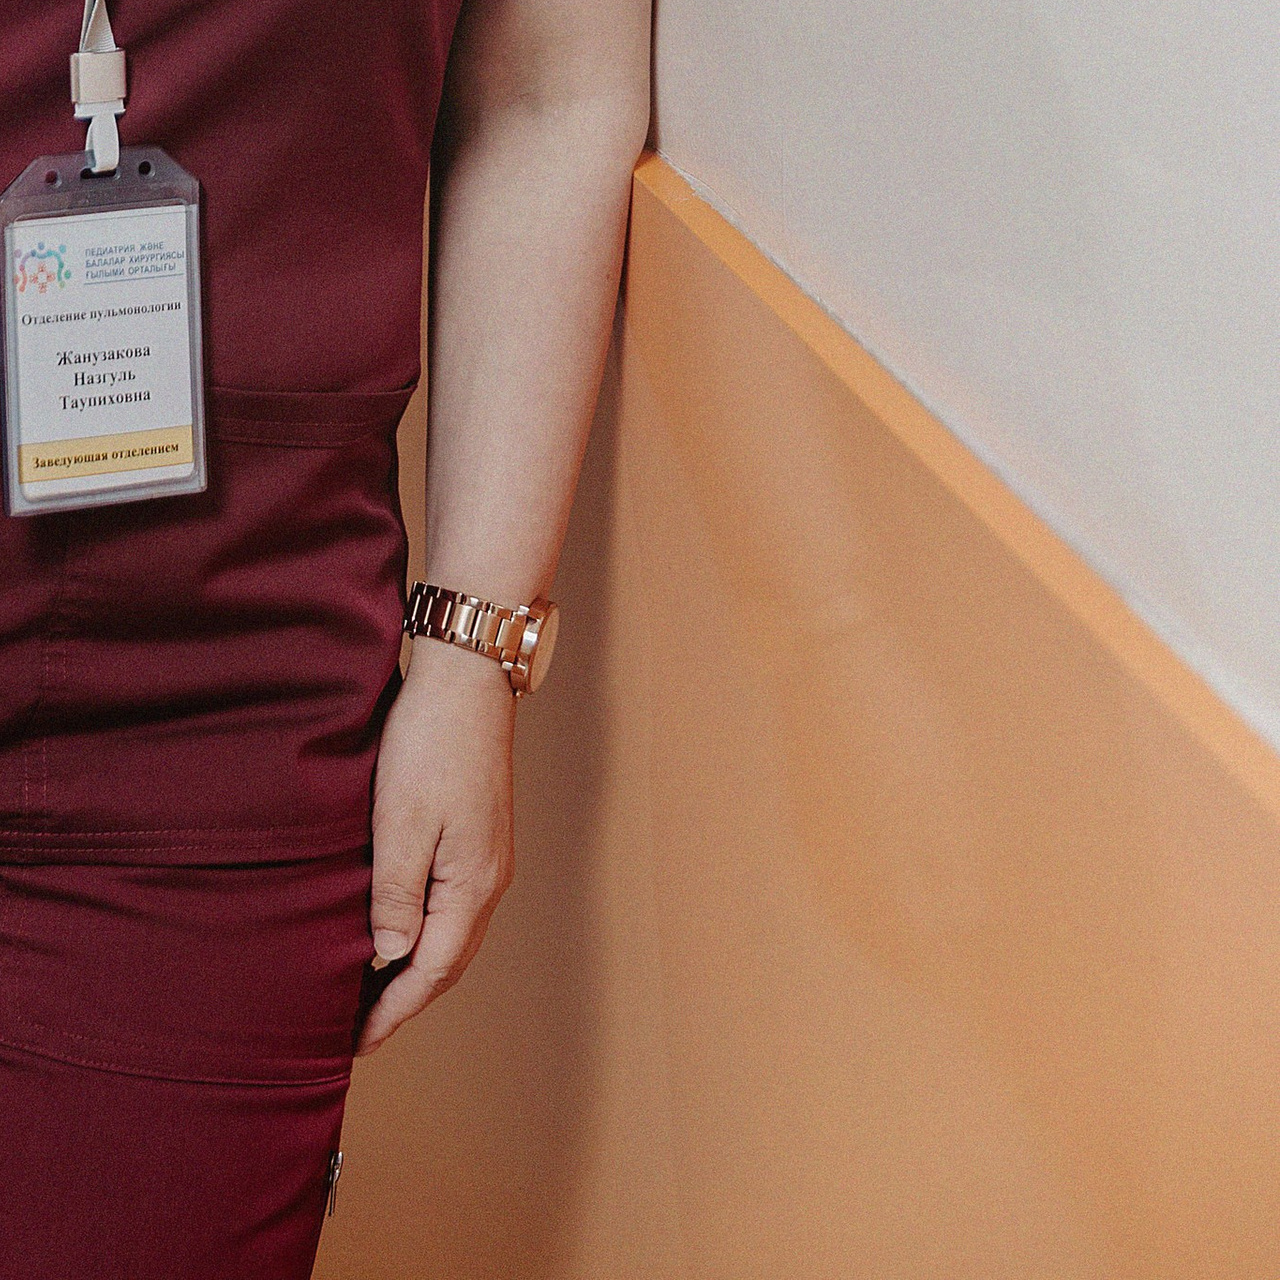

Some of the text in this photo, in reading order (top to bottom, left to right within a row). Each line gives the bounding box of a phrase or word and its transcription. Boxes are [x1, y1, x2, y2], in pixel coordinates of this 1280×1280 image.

[85, 241, 164, 257] ПЕДИАТРИЯ ЖӘНЕ
[85, 251, 185, 268] БАЛАЛАР ХИРУРГИЯСЫ
[21, 301, 181, 326] Отделение пульмонологии
[56, 346, 150, 366] Жанузакова
[74, 370, 136, 387] Назгуль
[59, 390, 151, 412] Таупиховна
[33, 443, 179, 469] Заведующая отделением
